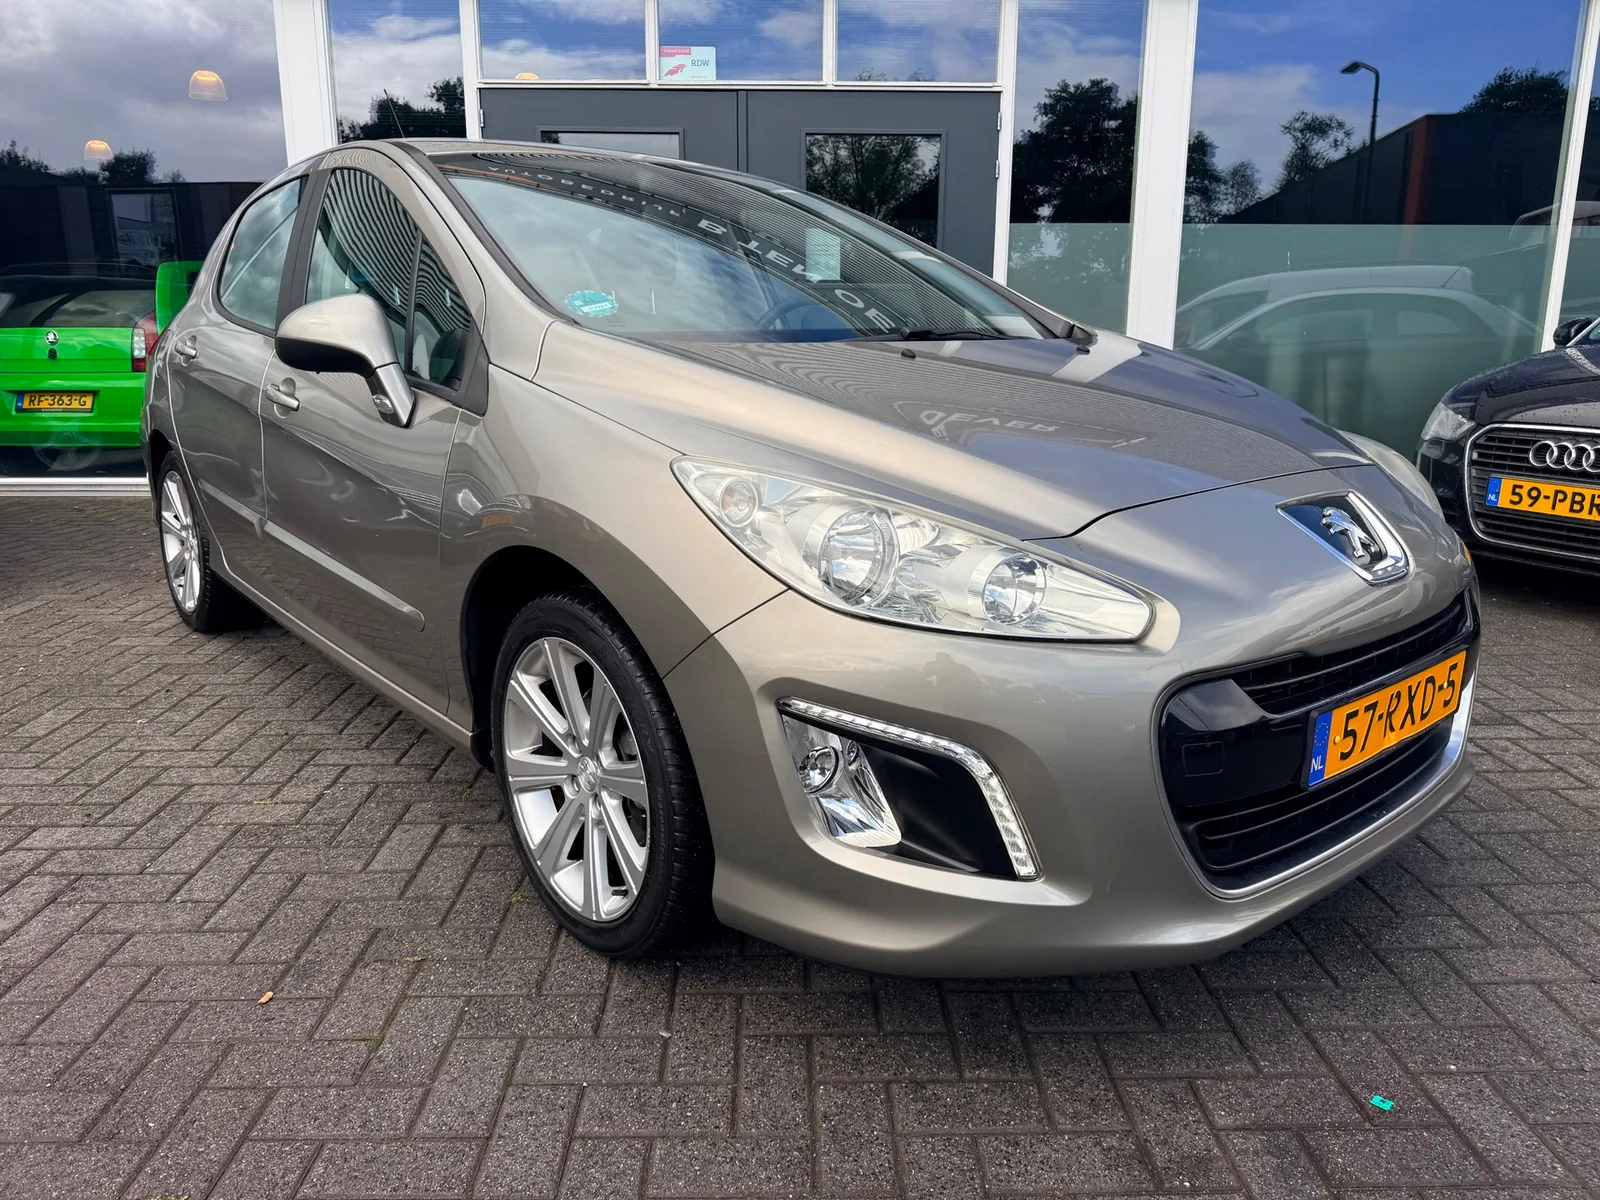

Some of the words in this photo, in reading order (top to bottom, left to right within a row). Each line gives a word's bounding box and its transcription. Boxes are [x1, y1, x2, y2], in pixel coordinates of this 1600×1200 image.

[690, 59, 710, 67] RDW
[28, 394, 87, 407] RF-363-G
[1487, 493, 1498, 502] NL
[1339, 661, 1459, 761] 57-RXD-5
[1310, 755, 1324, 774] NL
